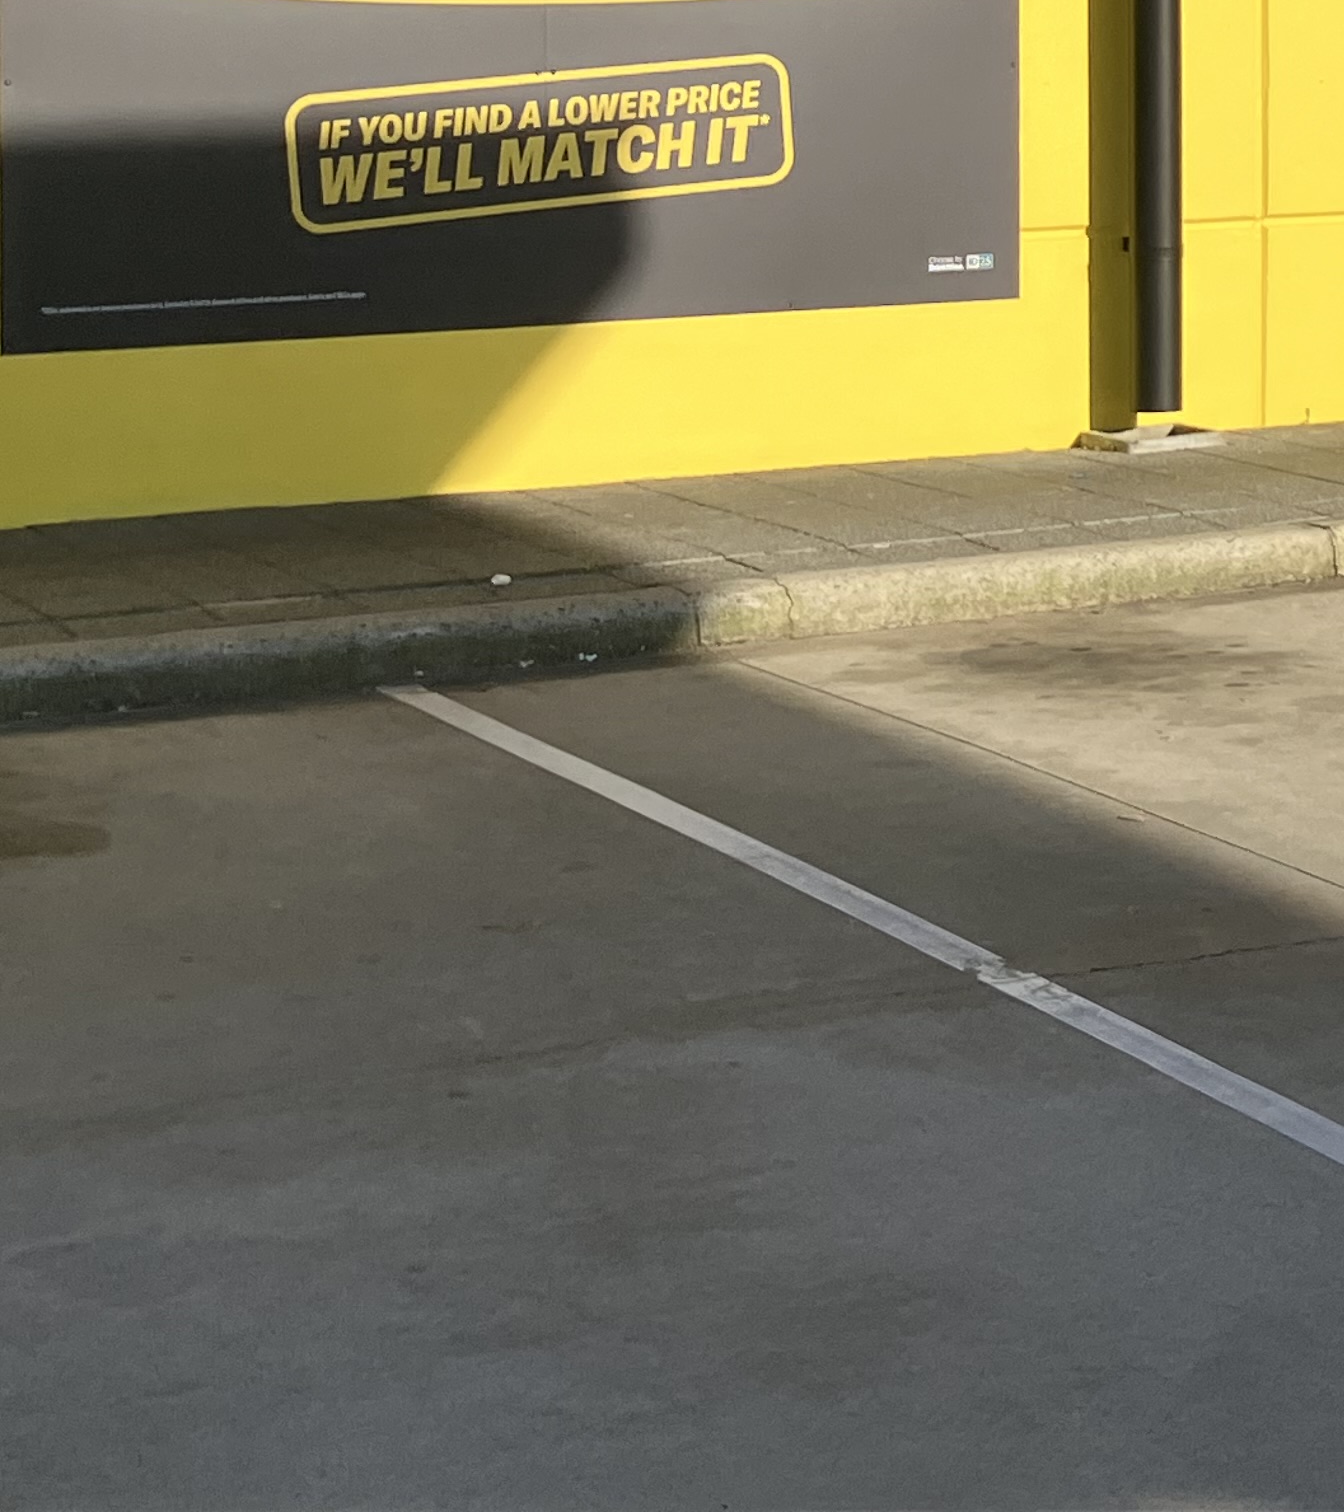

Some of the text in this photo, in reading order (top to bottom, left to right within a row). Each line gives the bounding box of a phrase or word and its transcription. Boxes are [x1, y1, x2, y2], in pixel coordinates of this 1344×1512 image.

[319, 79, 761, 150] IF YOU FIND A LOWER PRICE
[497, 120, 696, 187] MATCH
